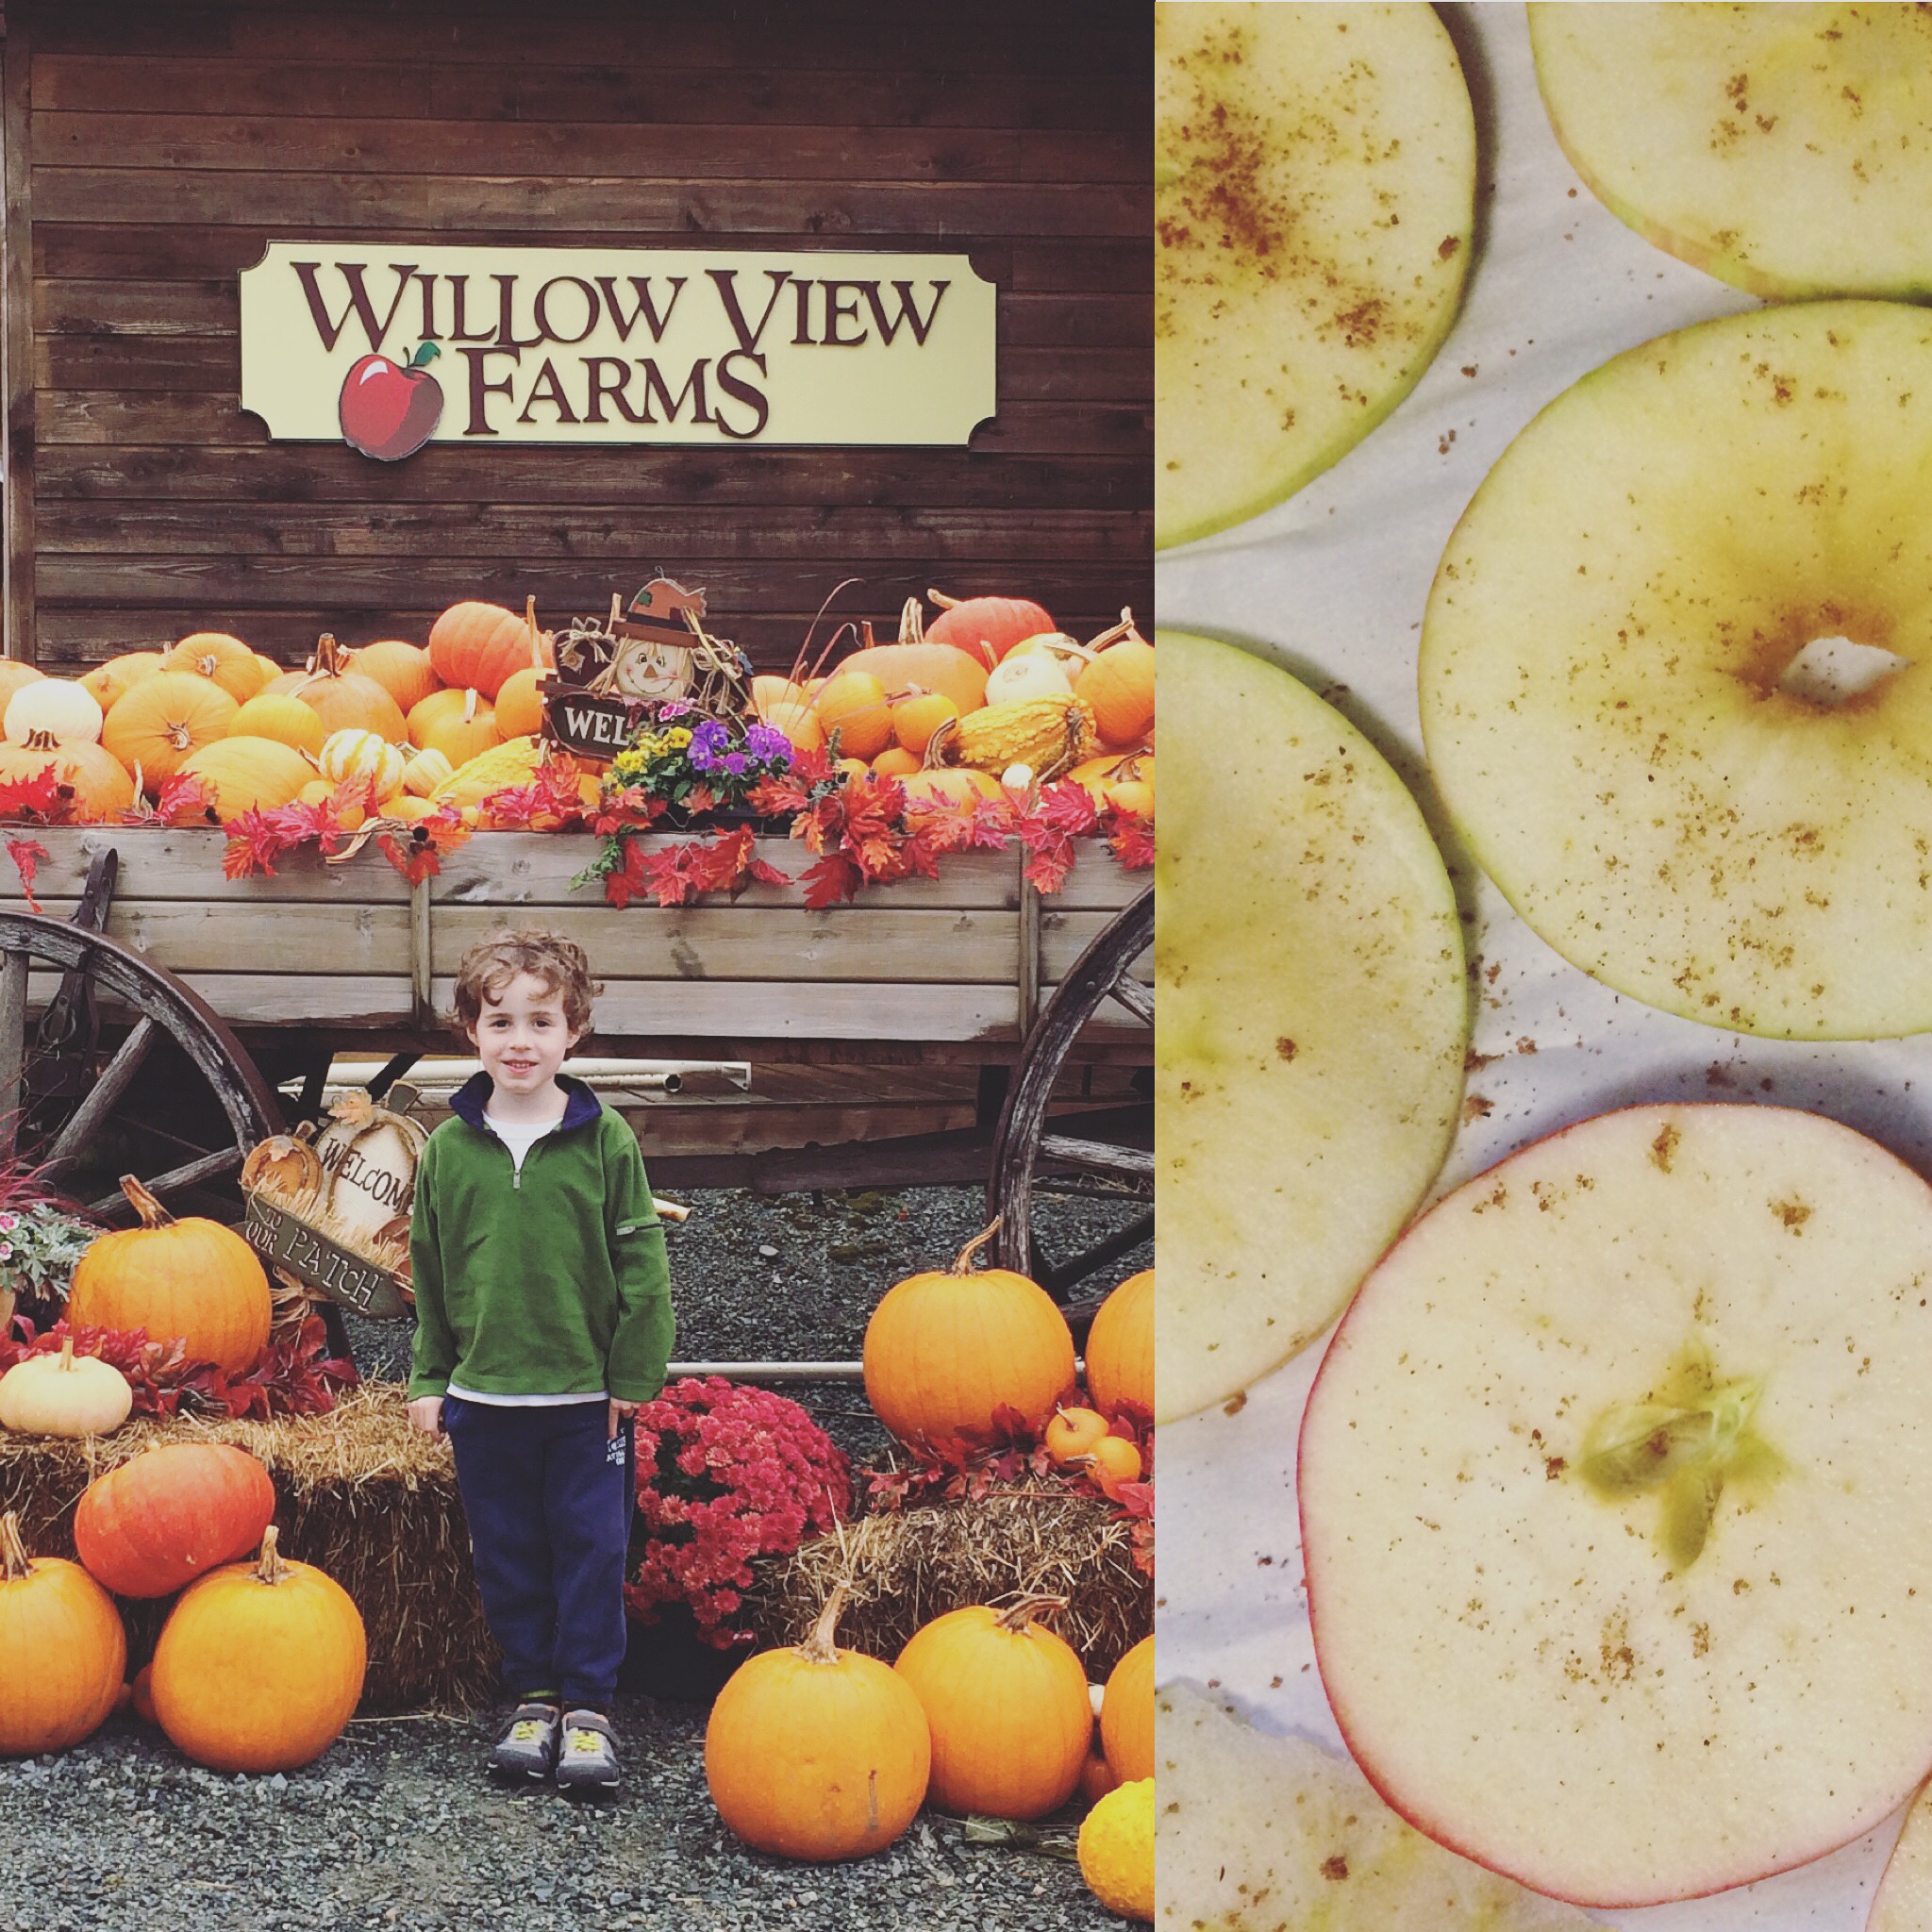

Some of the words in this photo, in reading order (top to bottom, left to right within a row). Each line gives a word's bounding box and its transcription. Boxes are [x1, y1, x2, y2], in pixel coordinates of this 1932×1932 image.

[290, 261, 689, 353] WILLOW
[704, 269, 951, 357] VIEW
[456, 346, 769, 440] FARMS
[564, 707, 629, 746] WEL
[322, 1137, 414, 1215] WELCOM
[245, 1221, 280, 1255] OUR
[282, 1227, 379, 1311] PATCH
